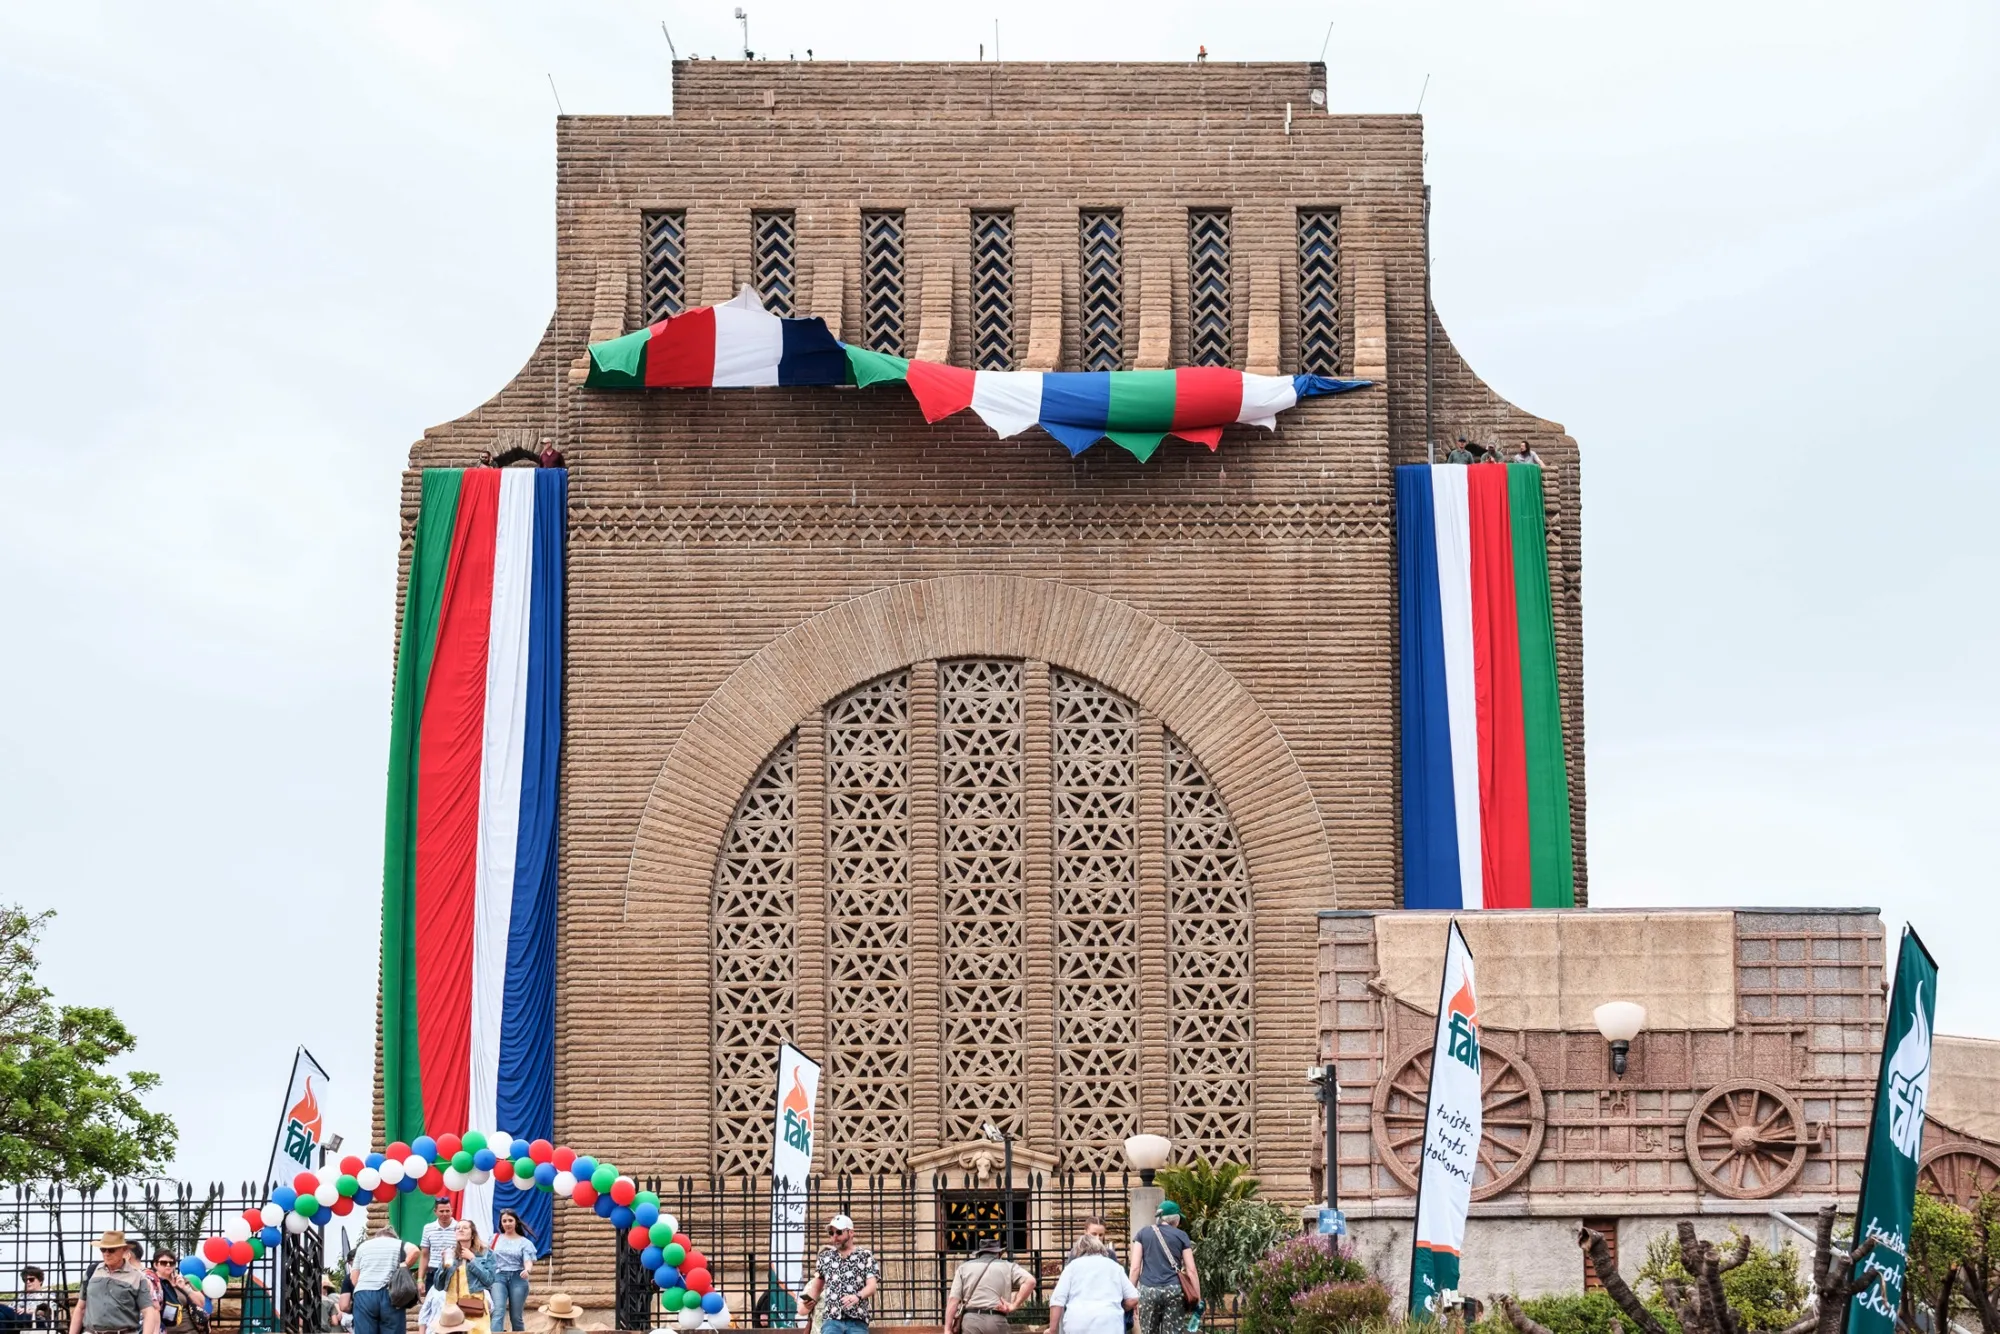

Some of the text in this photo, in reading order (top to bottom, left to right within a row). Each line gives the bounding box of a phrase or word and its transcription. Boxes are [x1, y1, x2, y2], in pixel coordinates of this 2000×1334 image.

[1448, 1012, 1479, 1076] fak
[283, 1119, 316, 1170] fak
[784, 1108, 811, 1157] fak
[1888, 1073, 1925, 1165] fak
